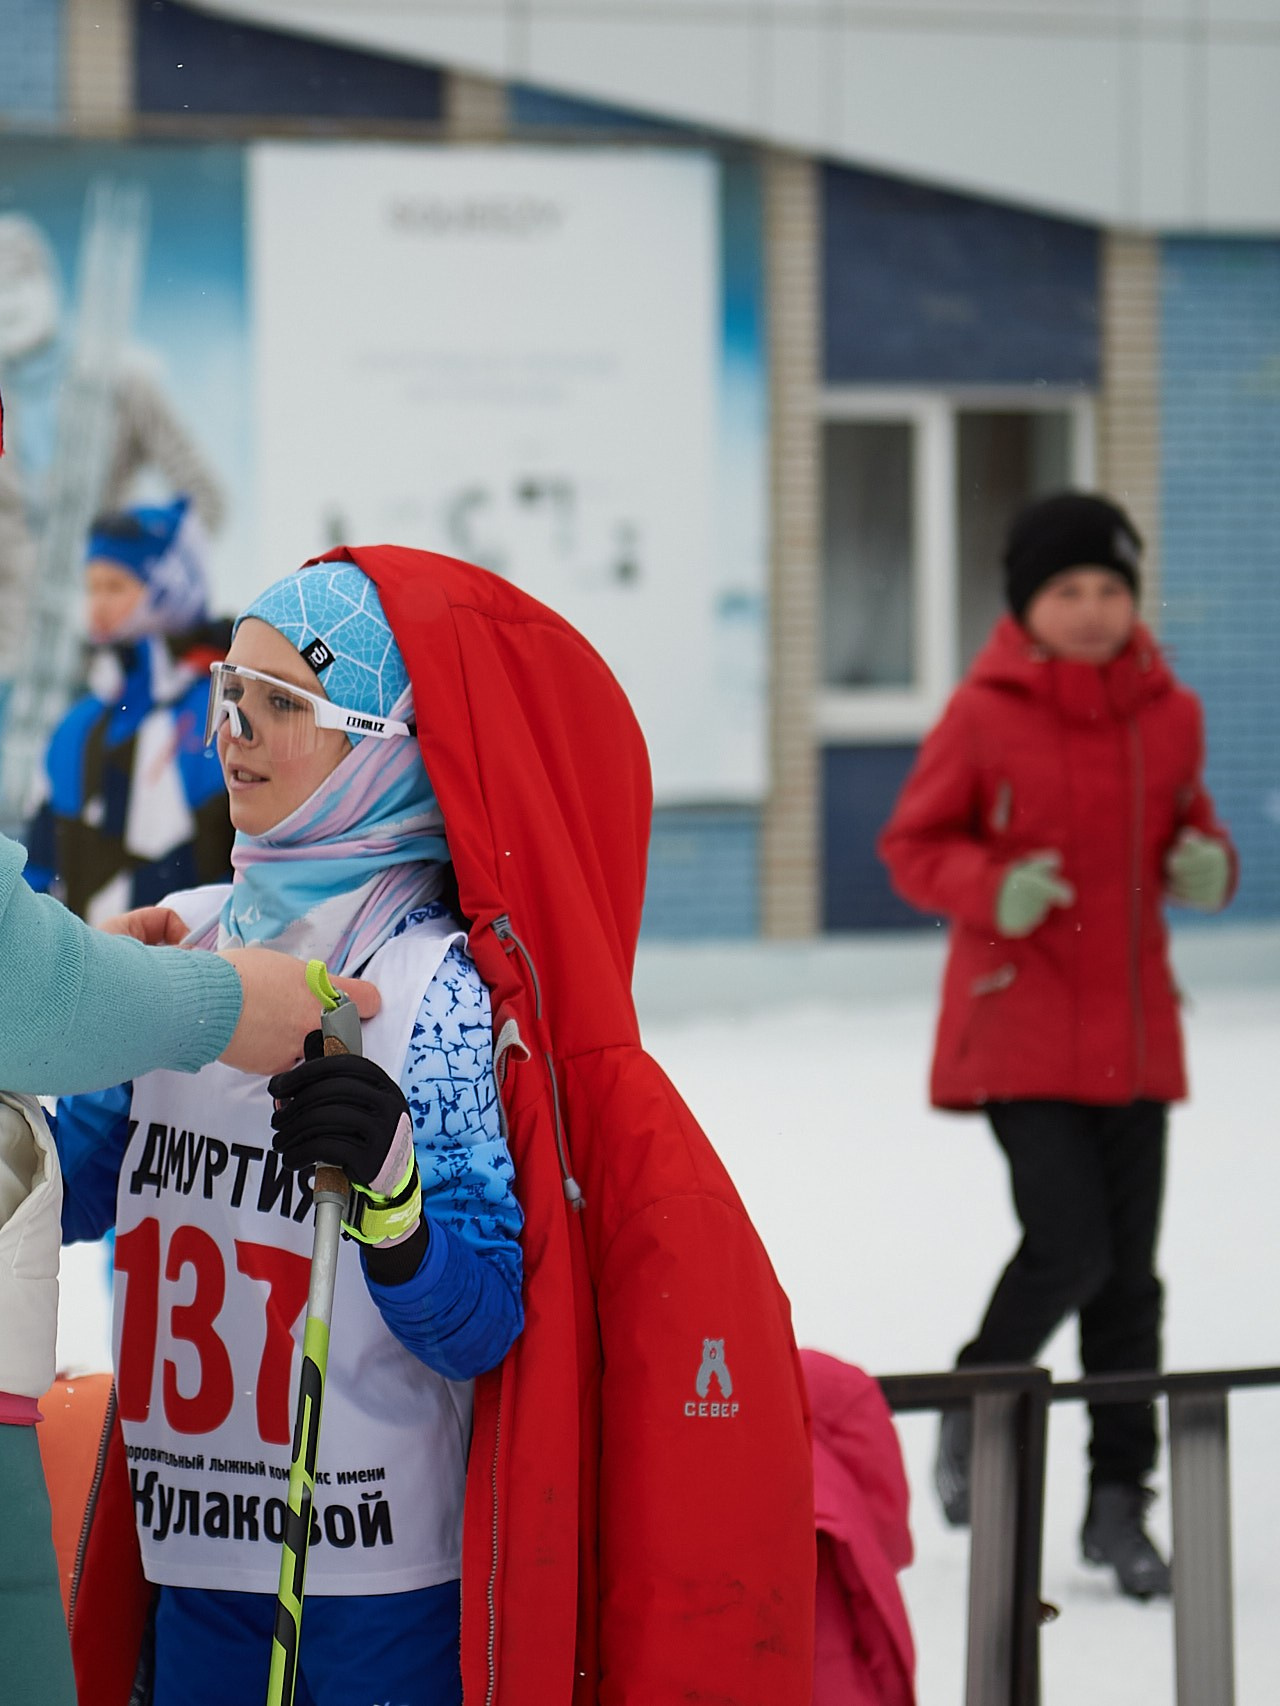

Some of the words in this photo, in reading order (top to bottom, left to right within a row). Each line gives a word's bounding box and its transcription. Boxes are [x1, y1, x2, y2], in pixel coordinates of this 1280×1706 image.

[114, 1216, 313, 1446] 137
[684, 1402, 739, 1417] СЕВЕР
[208, 1458, 266, 1477] лыжный
[269, 1466, 331, 1486] комкс
[336, 1467, 386, 1486] имени
